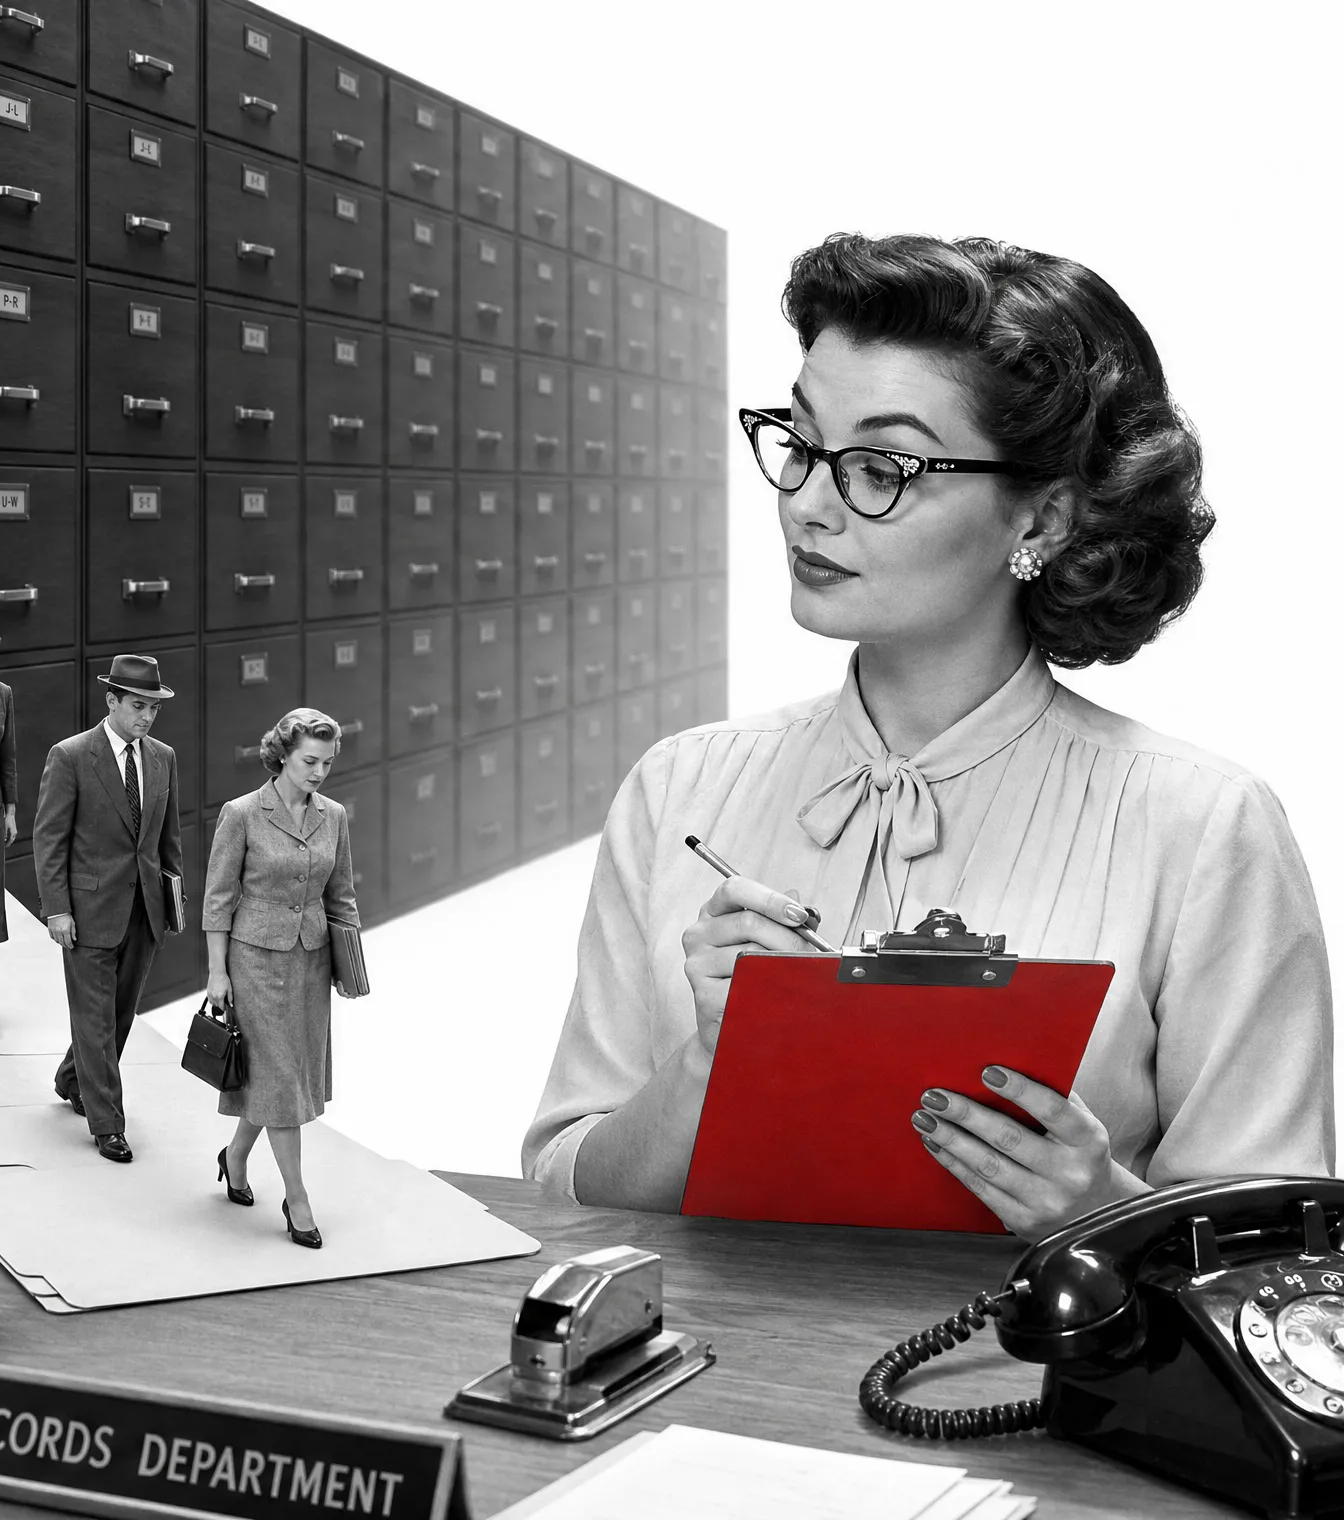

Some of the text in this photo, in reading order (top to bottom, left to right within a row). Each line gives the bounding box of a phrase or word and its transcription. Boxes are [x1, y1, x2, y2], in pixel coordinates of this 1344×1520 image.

[5, 102, 19, 116] J-L
[3, 294, 18, 308] P-R
[2, 496, 18, 508] U-W
[137, 1433, 404, 1516] DEPARTMENT
